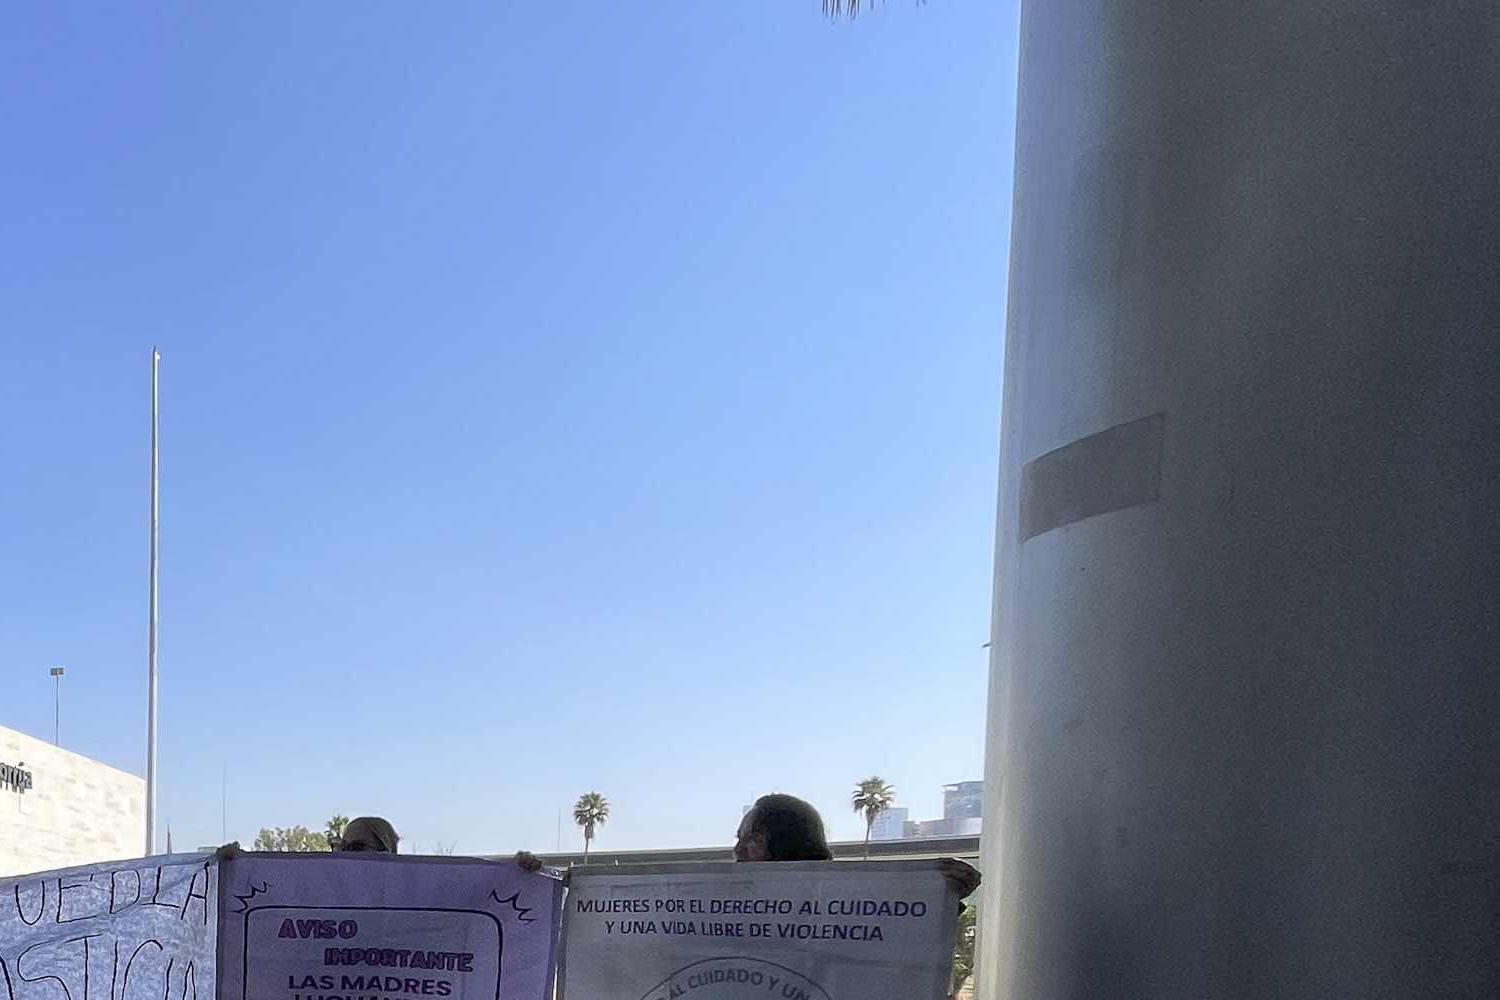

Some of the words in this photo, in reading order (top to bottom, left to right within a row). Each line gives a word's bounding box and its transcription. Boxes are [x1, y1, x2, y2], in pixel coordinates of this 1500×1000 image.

[576, 899, 650, 914] MUJERES
[654, 899, 686, 913] POR
[690, 899, 706, 914] EL
[710, 899, 792, 915] DERECHO
[799, 900, 821, 916] AL
[827, 900, 927, 917] CUIDADO
[278, 918, 358, 939] AVISO
[605, 921, 614, 934] Y
[620, 921, 657, 935] UNA
[661, 921, 697, 936] VIDA
[701, 922, 744, 937] LIBRE
[750, 923, 771, 937] DE
[776, 923, 884, 941] VIOLENCIA
[324, 948, 474, 972] IMPORTANTE
[288, 975, 334, 990] LAS
[341, 975, 452, 996] MADRES
[669, 983, 686, 1000] AL
[688, 968, 764, 989] CUIDADO
[768, 976, 780, 991] Y
